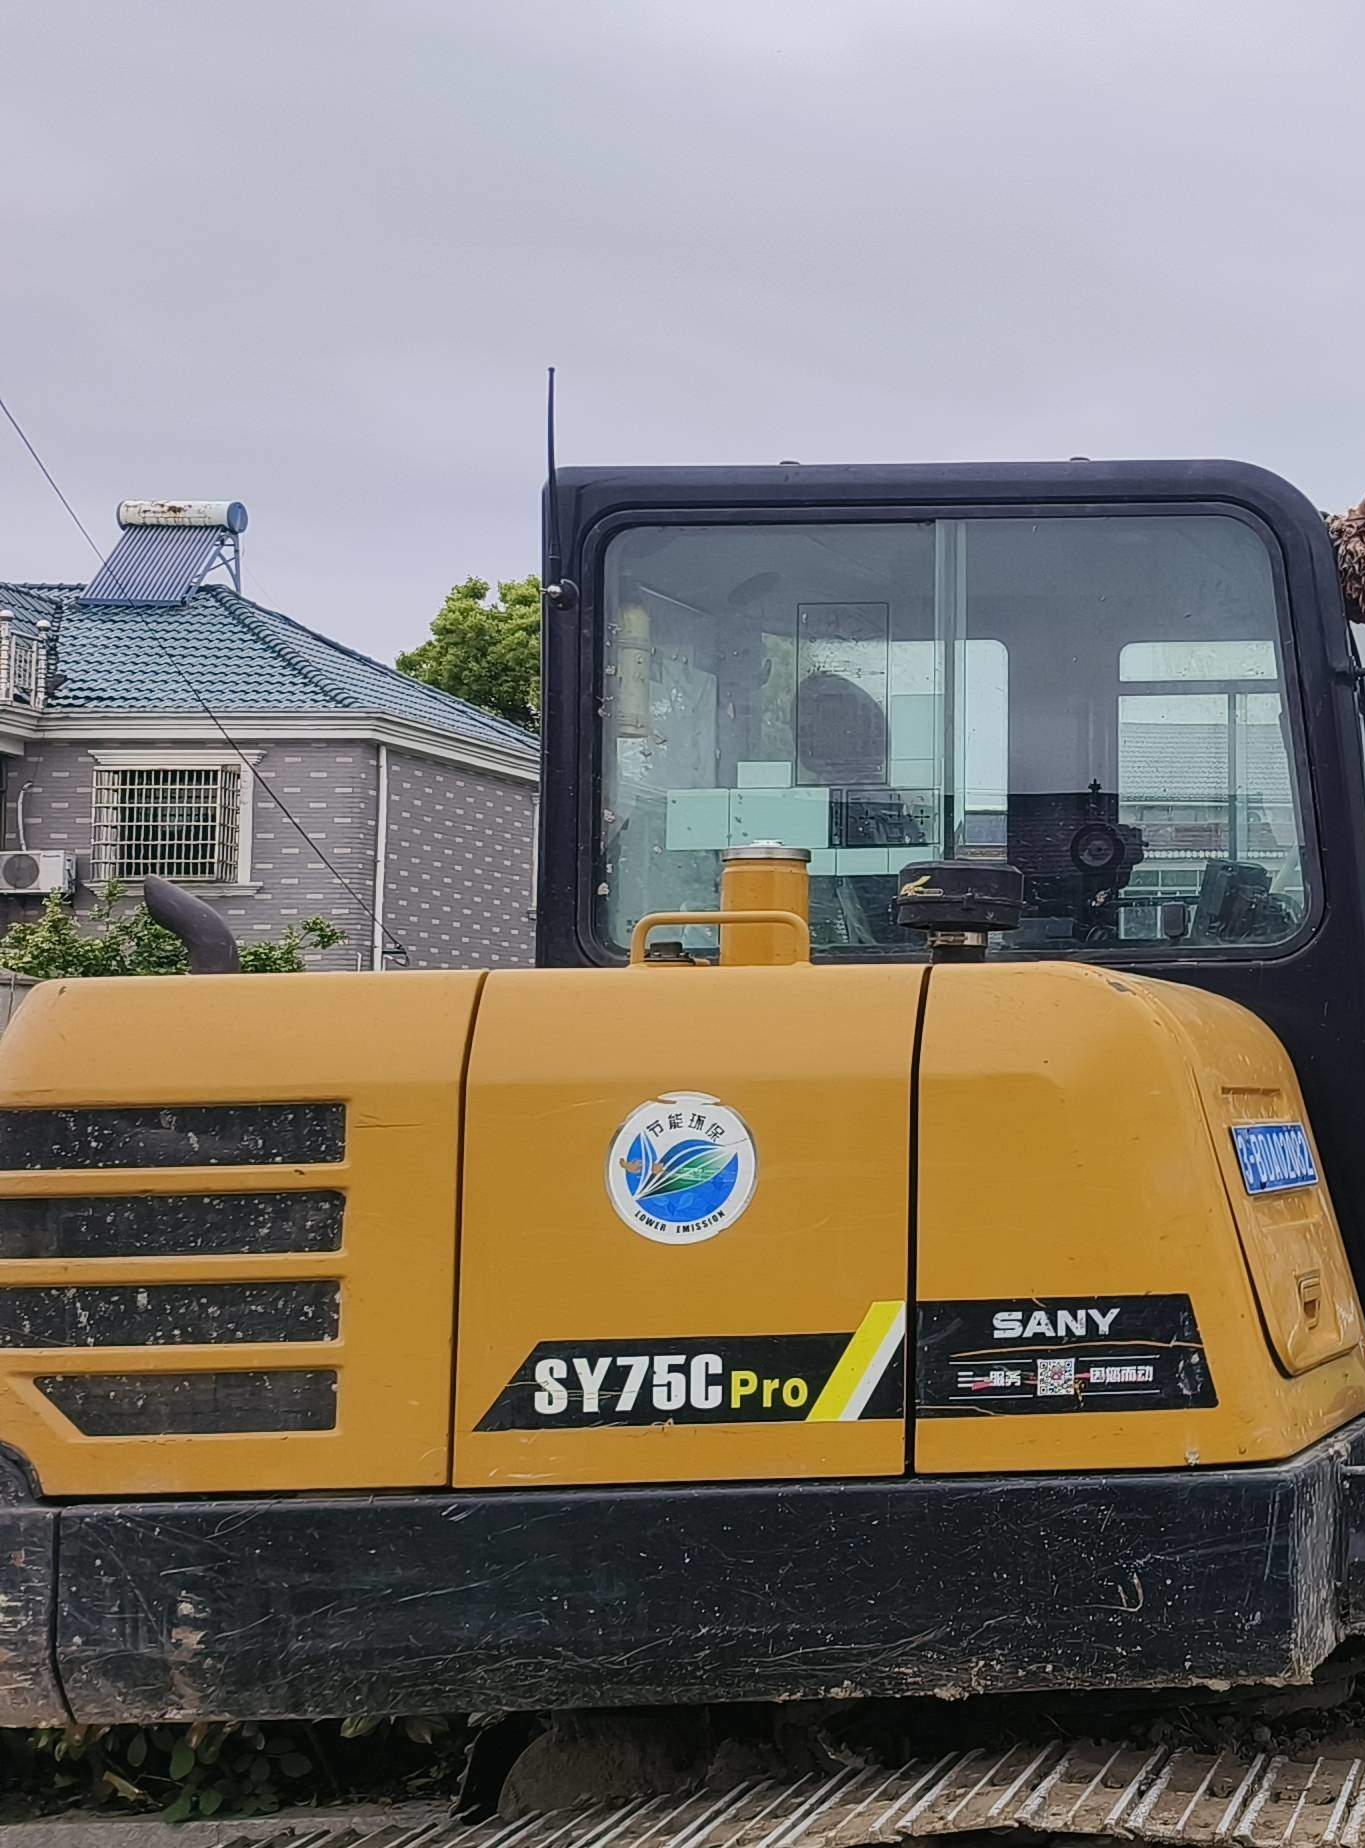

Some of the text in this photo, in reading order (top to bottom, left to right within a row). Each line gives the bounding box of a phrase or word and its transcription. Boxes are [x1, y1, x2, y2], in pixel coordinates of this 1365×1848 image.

[646, 1112, 725, 1142] 节能环保
[635, 1209, 726, 1234] LOWER EMISSION
[993, 1308, 1120, 1339] SANY
[534, 1353, 809, 1415] SY75C Pro
